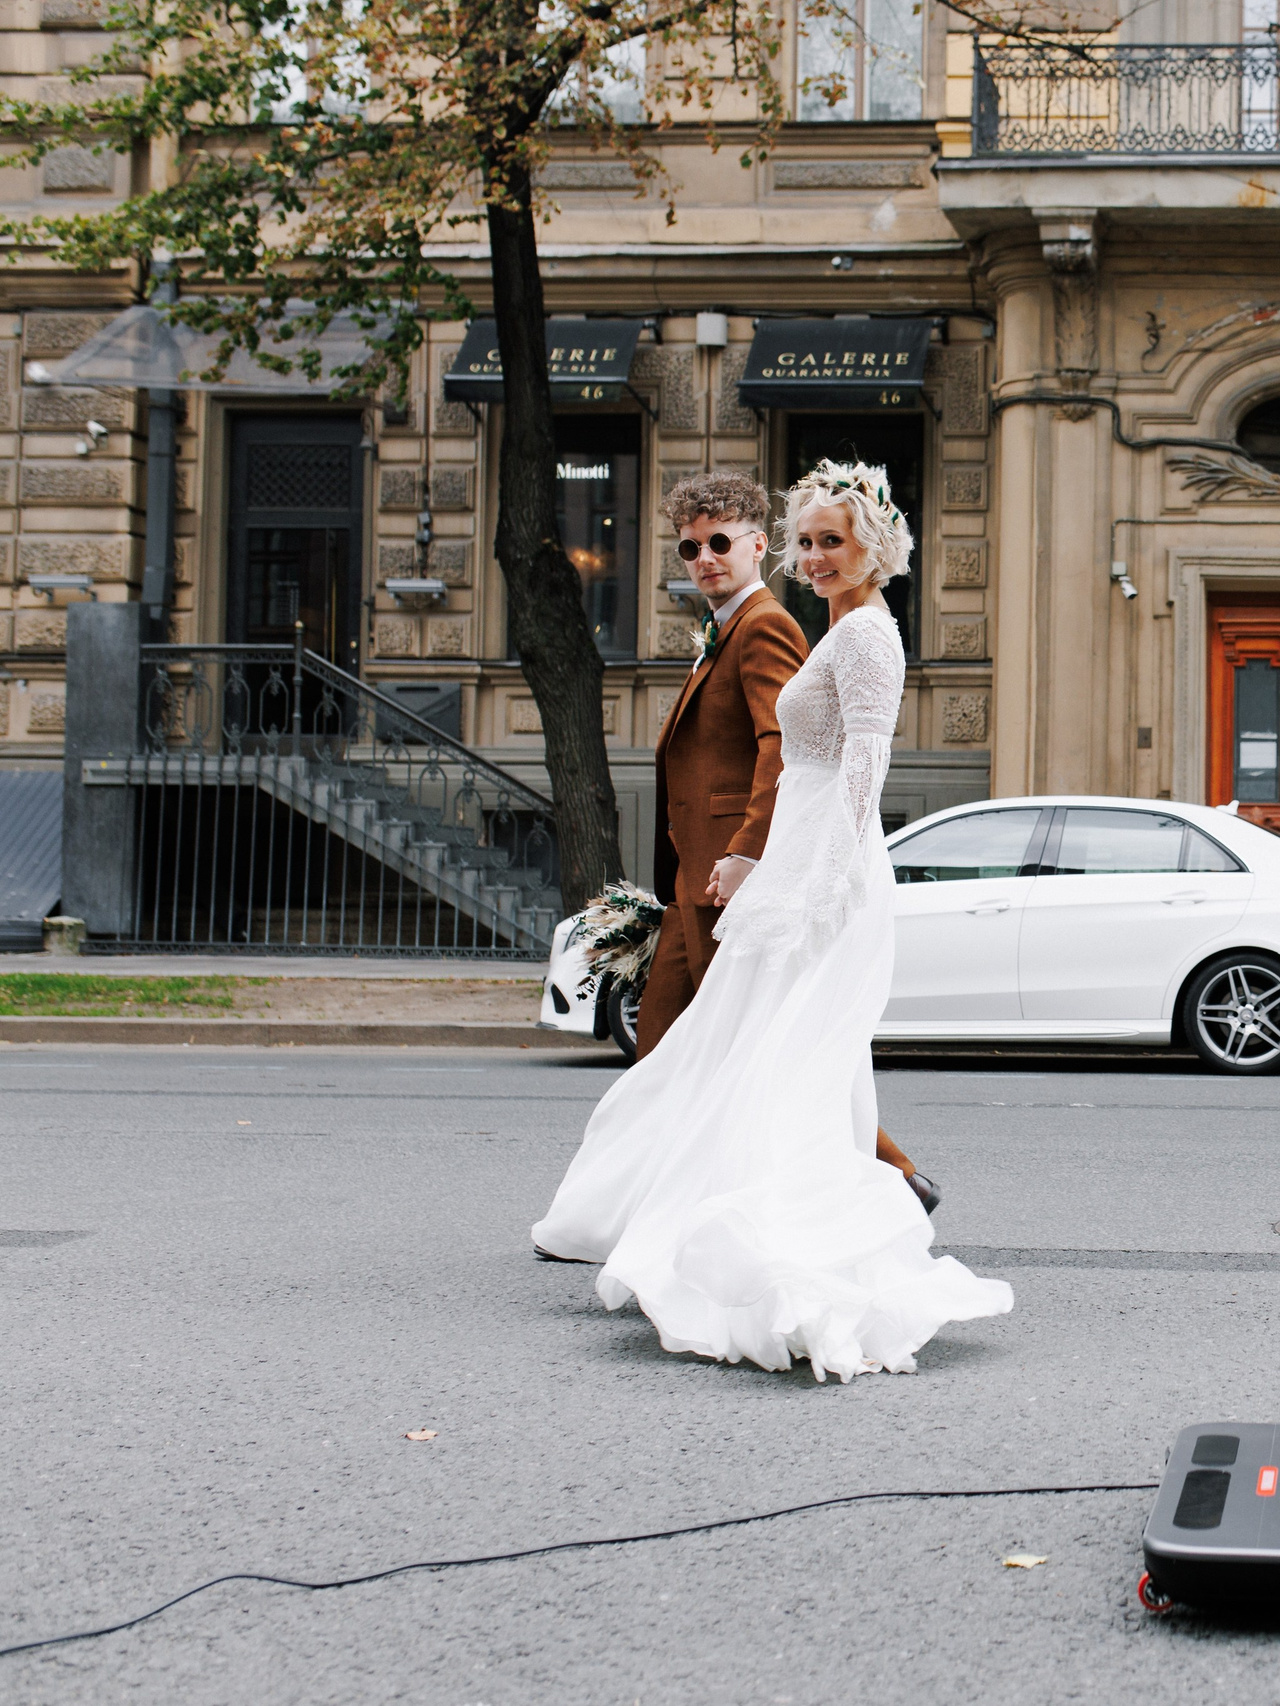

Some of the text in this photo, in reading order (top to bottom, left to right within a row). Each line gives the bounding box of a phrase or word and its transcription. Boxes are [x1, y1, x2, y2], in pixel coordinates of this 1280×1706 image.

[486, 347, 618, 363] GERIE
[777, 352, 910, 366] GALERIE
[761, 367, 893, 379] QUARANTE-SIX
[580, 385, 605, 400] 46
[878, 390, 901, 405] 46
[556, 462, 610, 480] Minotti
